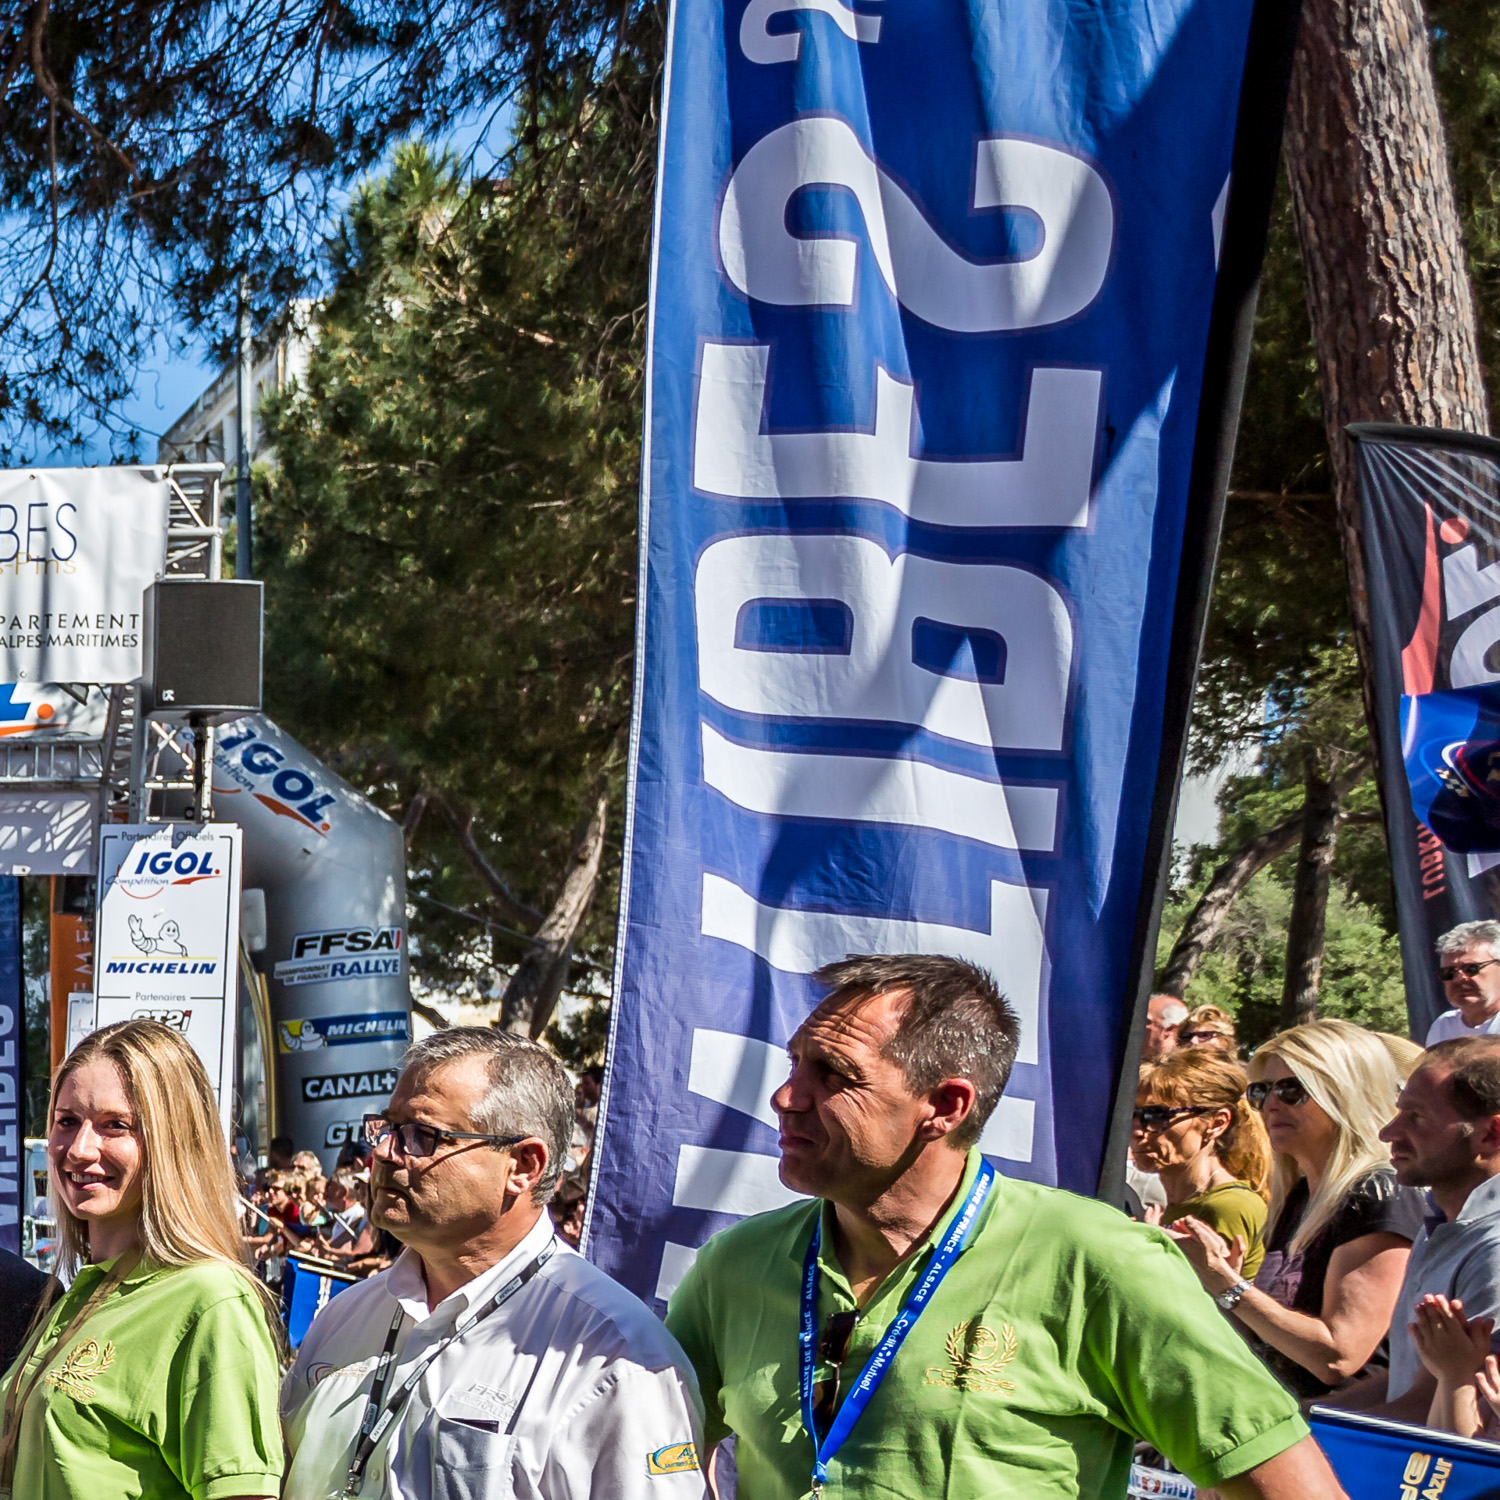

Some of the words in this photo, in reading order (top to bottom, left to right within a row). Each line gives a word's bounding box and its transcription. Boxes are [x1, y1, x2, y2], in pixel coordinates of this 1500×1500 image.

[121, 831, 172, 845] Partenaires
[176, 831, 214, 842] Officiels
[294, 930, 395, 959] FFSA
[106, 962, 217, 975] MICHELIN
[331, 957, 400, 978] RALLYE
[136, 992, 186, 1002] Partenaires
[328, 1019, 407, 1036] MICHELIN
[305, 1072, 397, 1099] CANAL+
[971, 1172, 991, 1205] RALLYE
[943, 1215, 971, 1254] FRANCE
[806, 1263, 815, 1301] ALSACE
[914, 1262, 943, 1303] ALSACE
[803, 1364, 814, 1398] RALLYE
[860, 1355, 887, 1392] Mutuel
